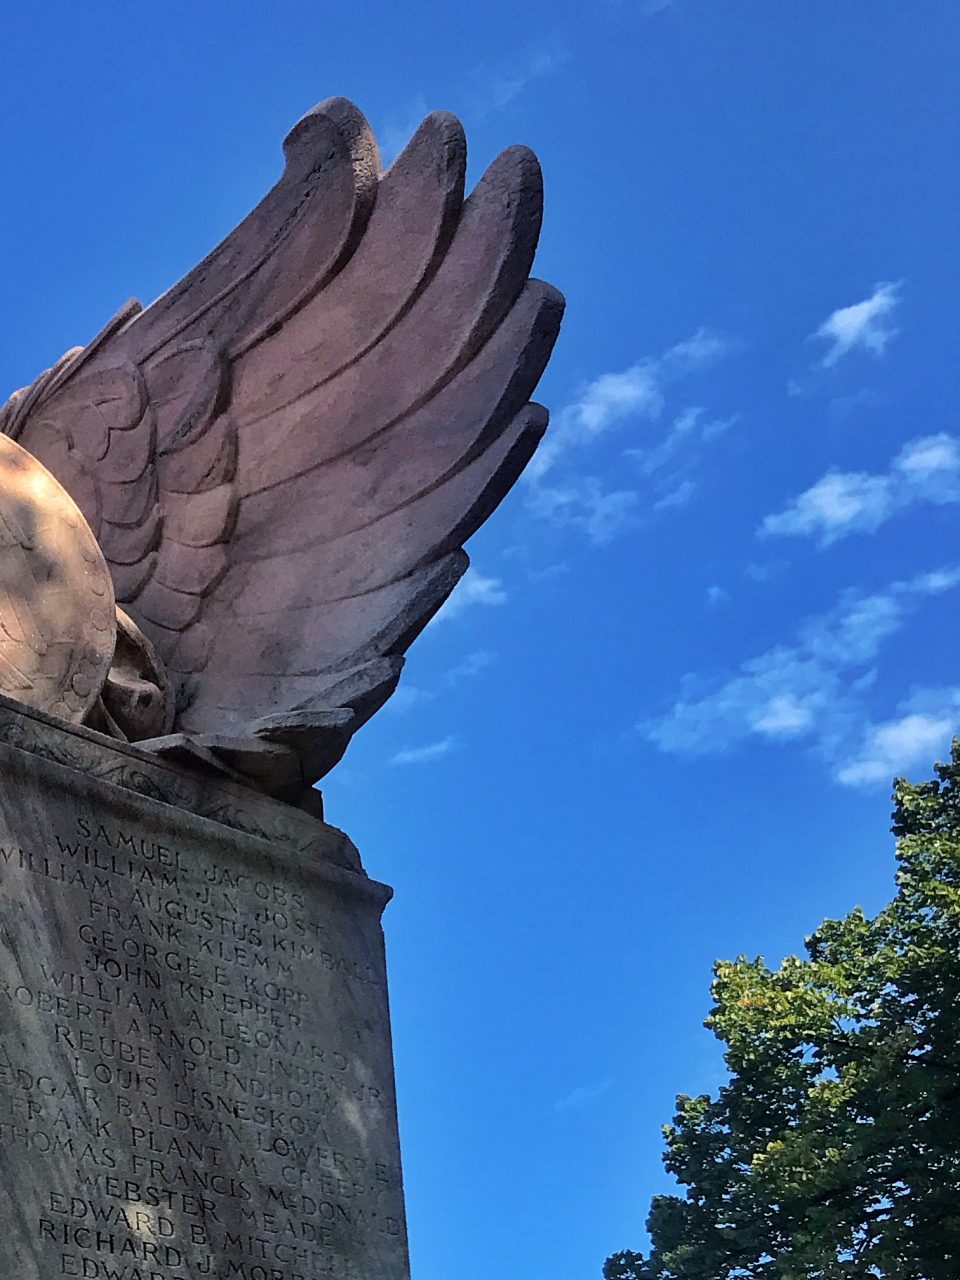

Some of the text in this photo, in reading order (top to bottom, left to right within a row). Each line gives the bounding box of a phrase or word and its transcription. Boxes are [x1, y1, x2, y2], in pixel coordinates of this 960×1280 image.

[55, 835, 181, 896] WILLIAM
[252, 903, 325, 944] JOST
[76, 816, 305, 914] SAMUEL JACOBS
[78, 921, 203, 980] GEORGE
[243, 974, 310, 1013] KOPP
[88, 899, 294, 983] FRANK KLEMM
[129, 885, 262, 947] AUGUSTUS
[271, 933, 378, 985] KIMBALL
[41, 963, 169, 1020] WILLIAM
[219, 1016, 348, 1073] LEONARD
[84, 950, 302, 1035] JOHN KREPPER
[55, 1022, 171, 1075] REUBEN
[73, 1055, 158, 1098] LOUIS
[126, 1015, 240, 1066] ARNOLD
[9, 1094, 114, 1142] FRANK
[131, 1125, 221, 1169] PLANT
[116, 1094, 242, 1146] BALDWIN
[48, 1190, 175, 1240] EDWARD
[76, 1167, 335, 1248] WEBSTER MEADE
[132, 1153, 251, 1203] FRANCIS
[38, 1217, 181, 1270] RICHARD
